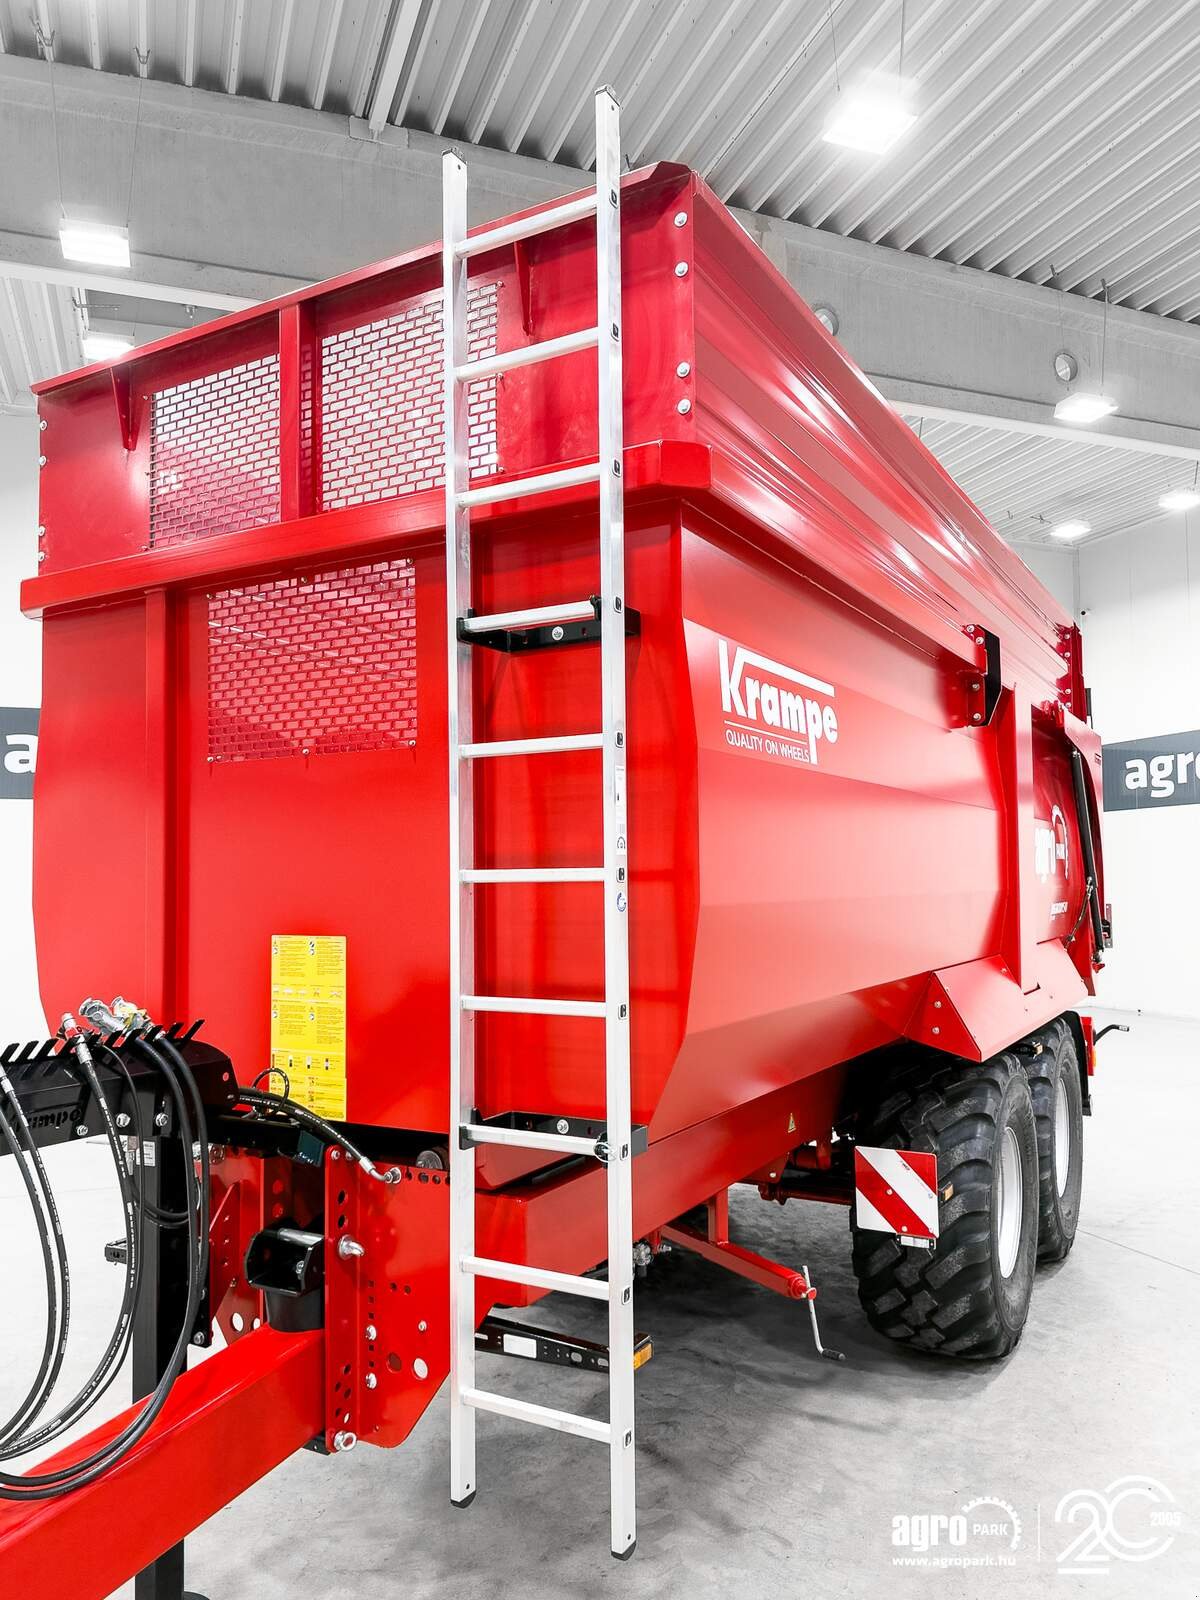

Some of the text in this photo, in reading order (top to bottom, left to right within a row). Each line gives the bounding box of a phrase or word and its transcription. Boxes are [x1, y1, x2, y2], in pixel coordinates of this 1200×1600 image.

[719, 638, 838, 765] Krampe
[726, 729, 809, 763] QUALITY ON WHEELS
